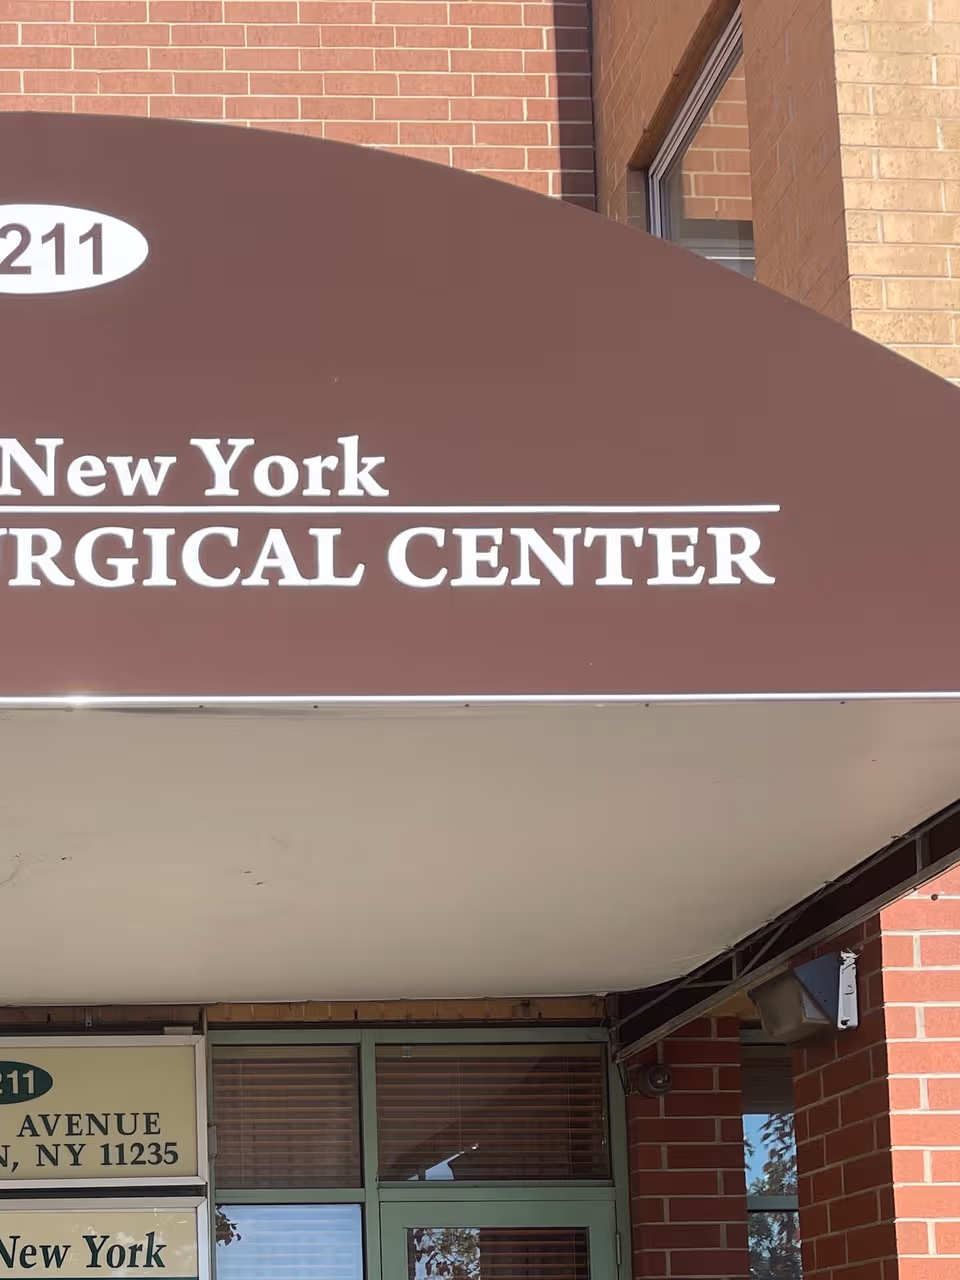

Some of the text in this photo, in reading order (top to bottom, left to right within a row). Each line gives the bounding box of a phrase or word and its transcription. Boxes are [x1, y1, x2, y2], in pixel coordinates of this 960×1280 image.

[190, 435, 389, 496] York
[388, 526, 775, 587] CENTER
[17, 1113, 161, 1137] AVENUE
[35, 1144, 86, 1167] NY
[100, 1142, 179, 1166] 11235
[82, 1232, 167, 1268] York
